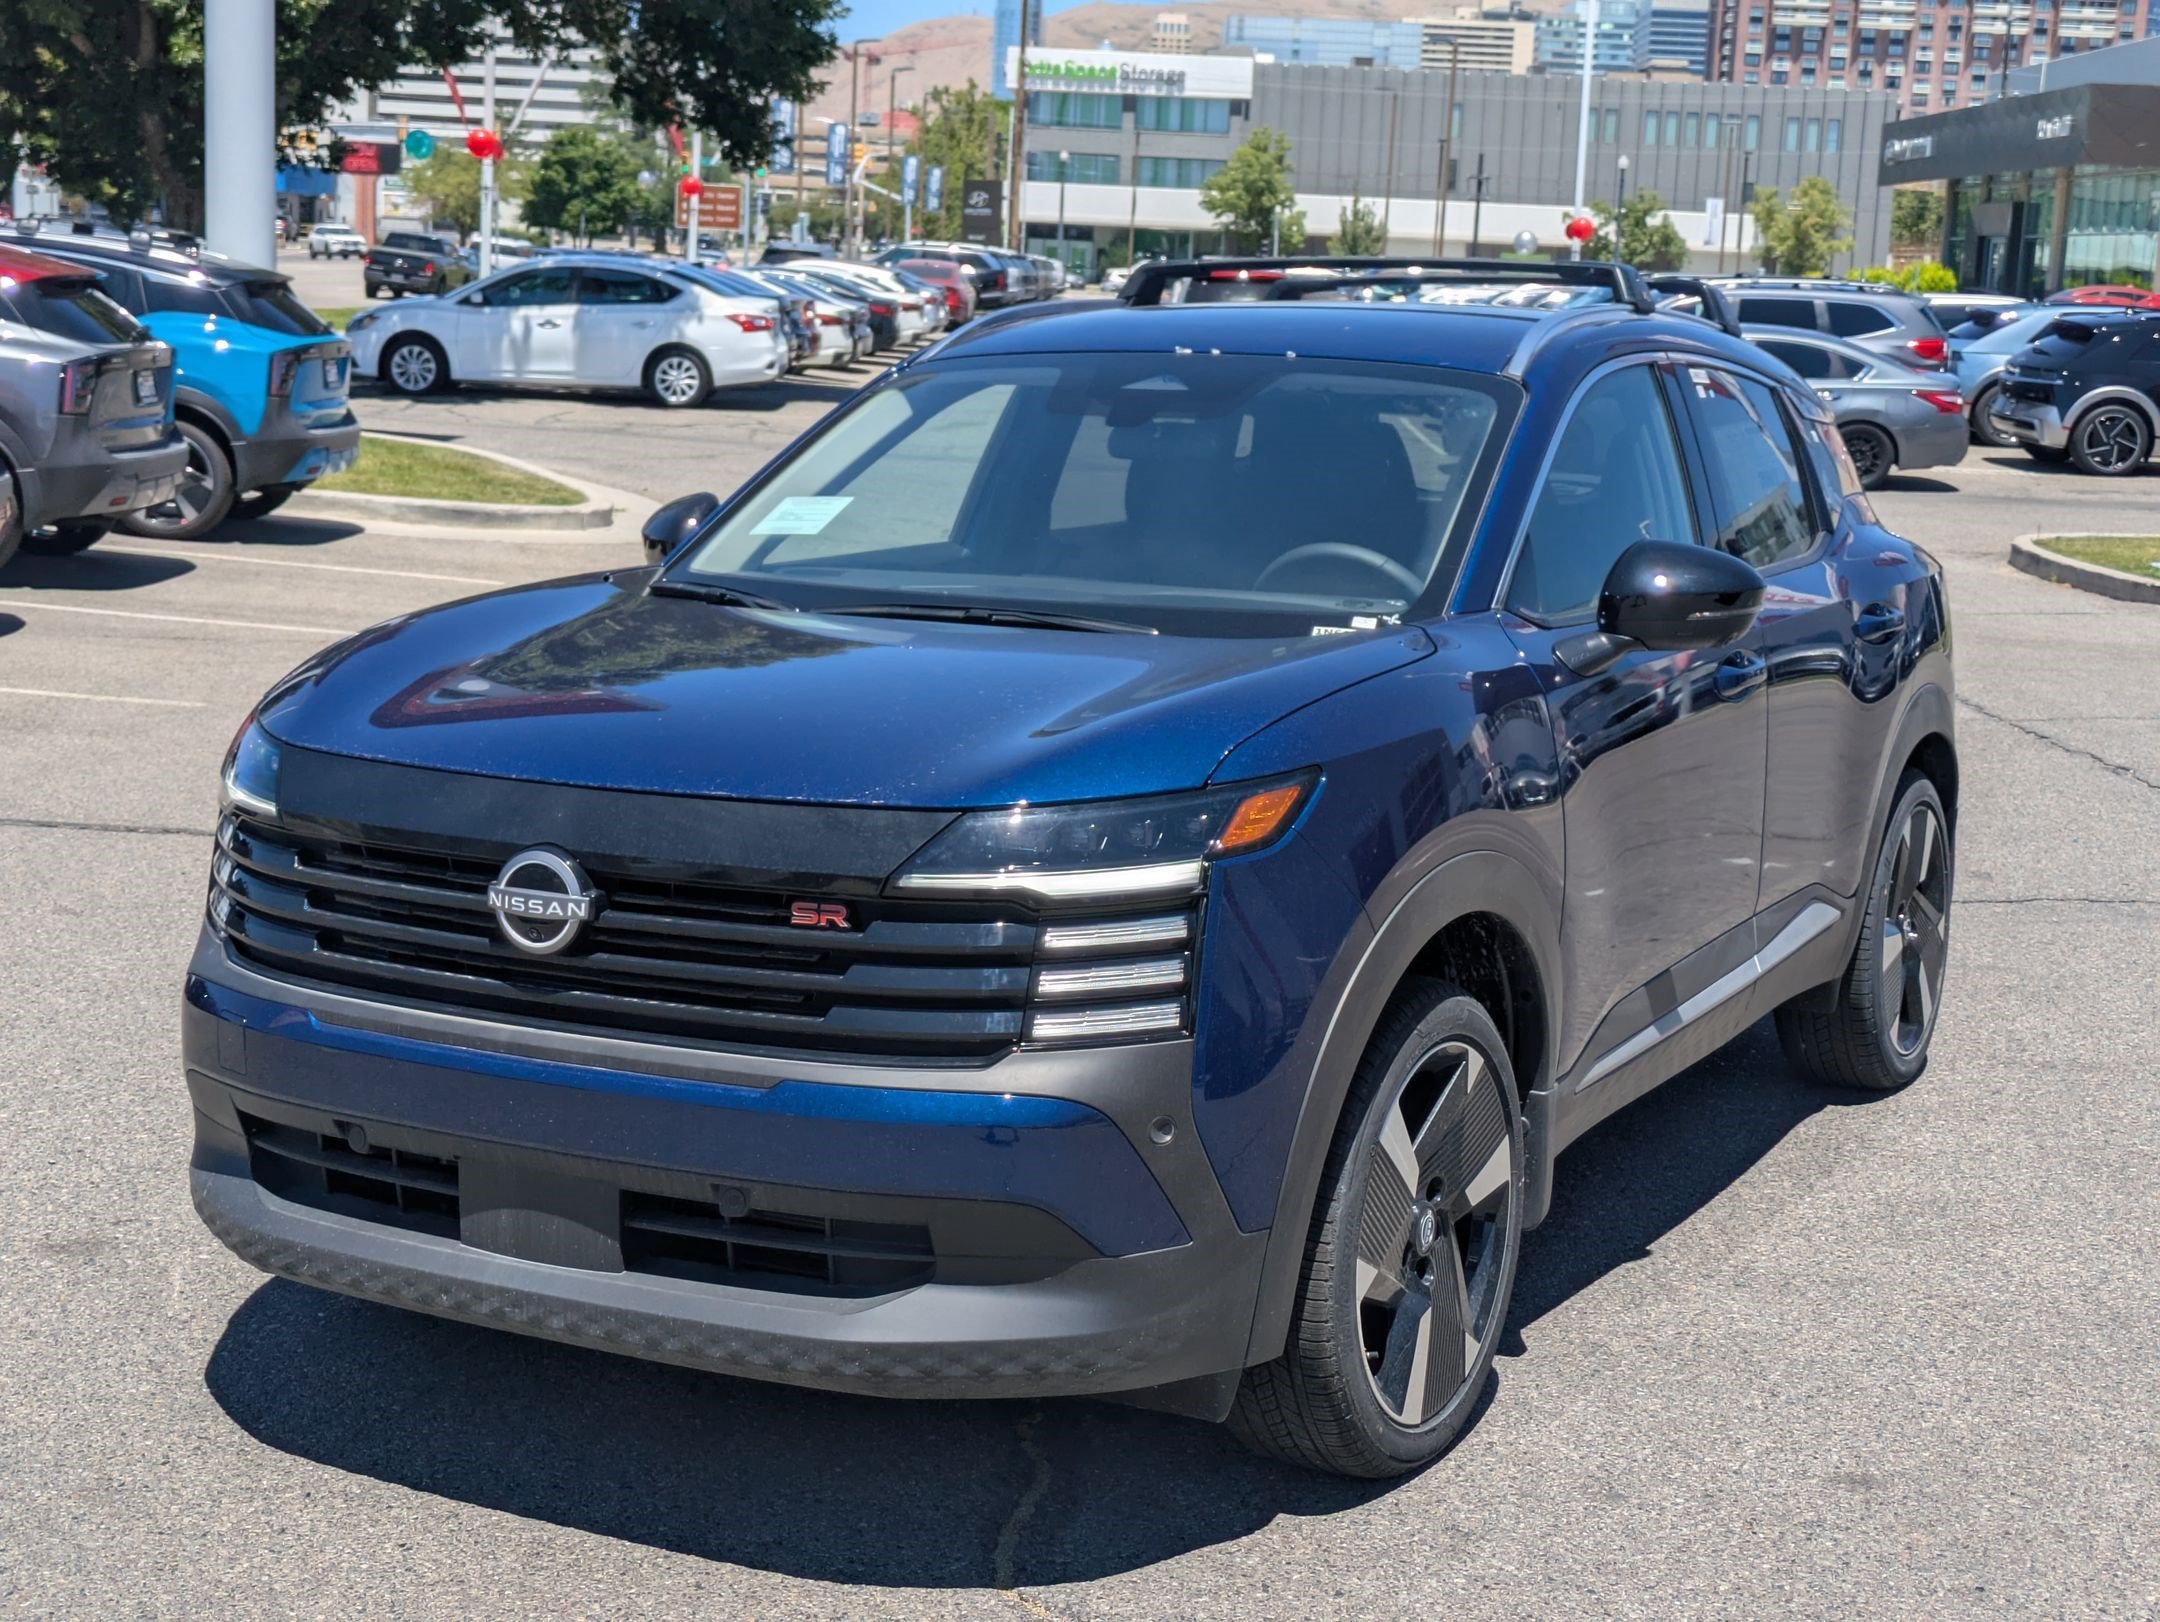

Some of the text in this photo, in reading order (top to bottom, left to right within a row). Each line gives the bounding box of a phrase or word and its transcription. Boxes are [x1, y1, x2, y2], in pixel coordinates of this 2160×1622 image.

[1120, 63, 1186, 86] Storage
[489, 891, 586, 917] NISSAN
[791, 902, 851, 927] SR
